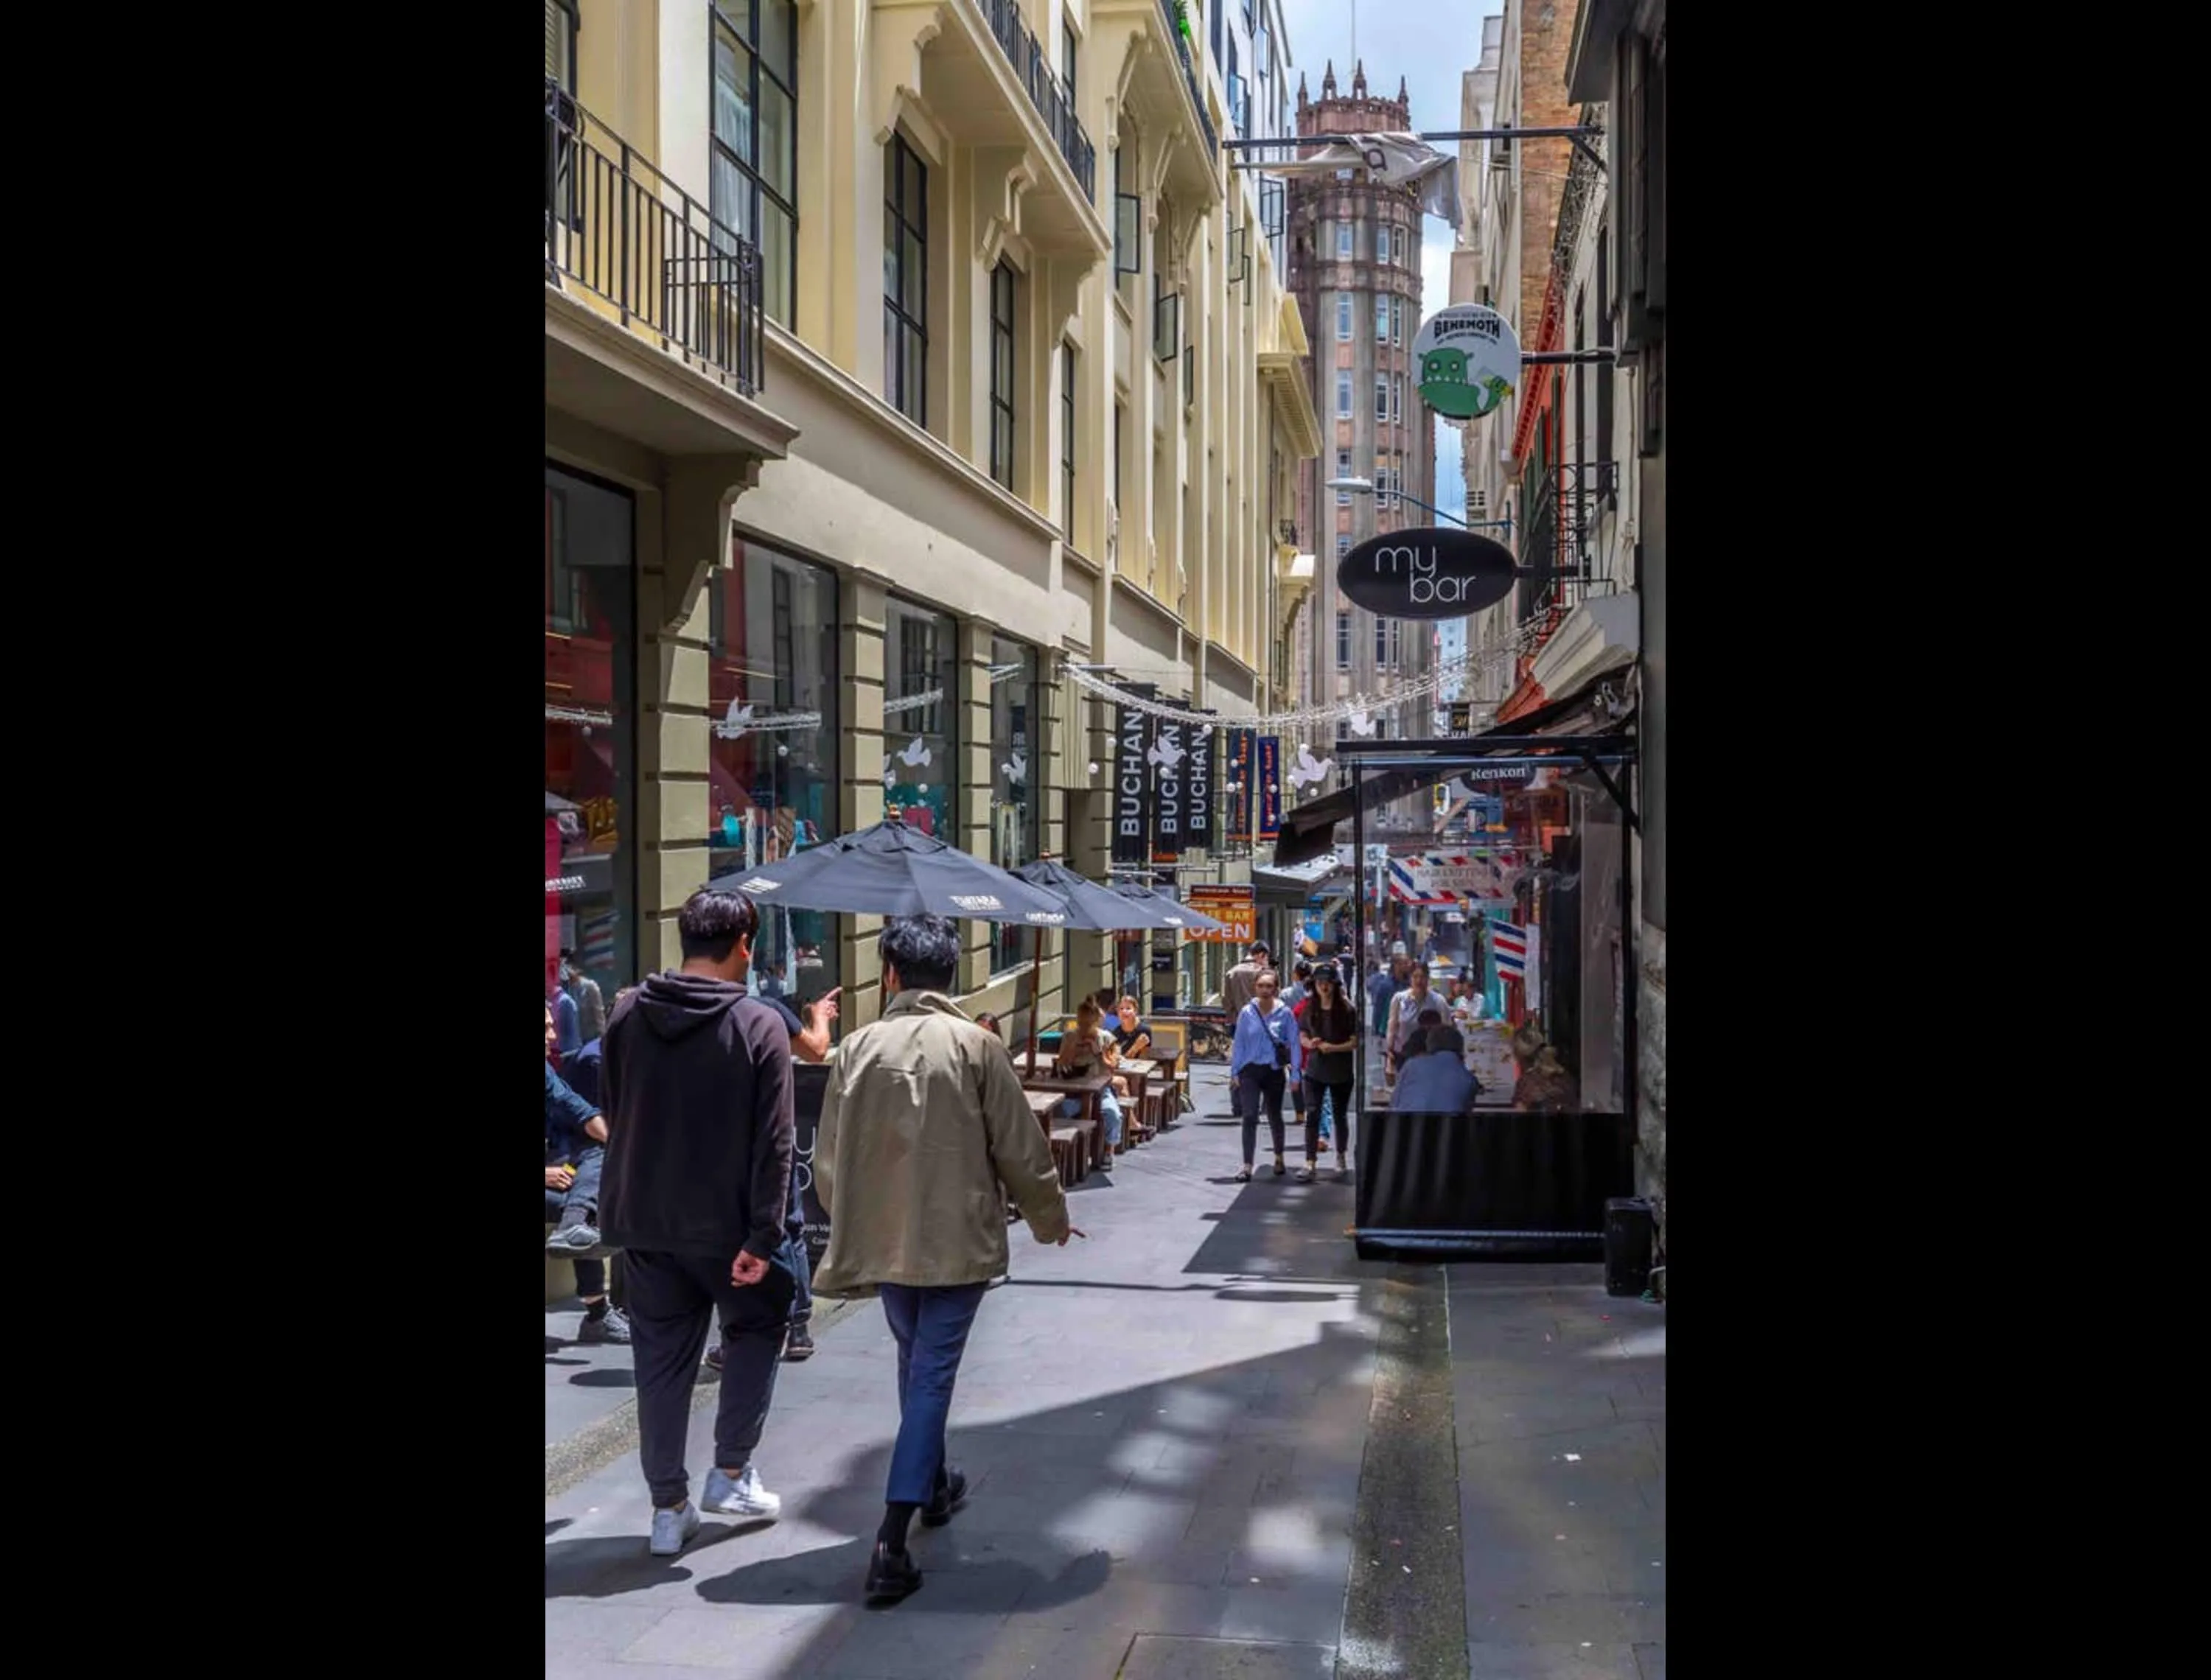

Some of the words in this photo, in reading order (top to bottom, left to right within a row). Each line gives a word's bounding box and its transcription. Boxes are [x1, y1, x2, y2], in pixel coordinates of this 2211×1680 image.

[1434, 319, 1500, 339] BEHEMOTH
[1375, 546, 1436, 578] my
[1410, 570, 1476, 603] bar
[1120, 711, 1143, 836] BUCHAN
[1190, 730, 1207, 830] BUCHAN
[1226, 910, 1250, 921] BAR
[793, 1127, 816, 1163] y
